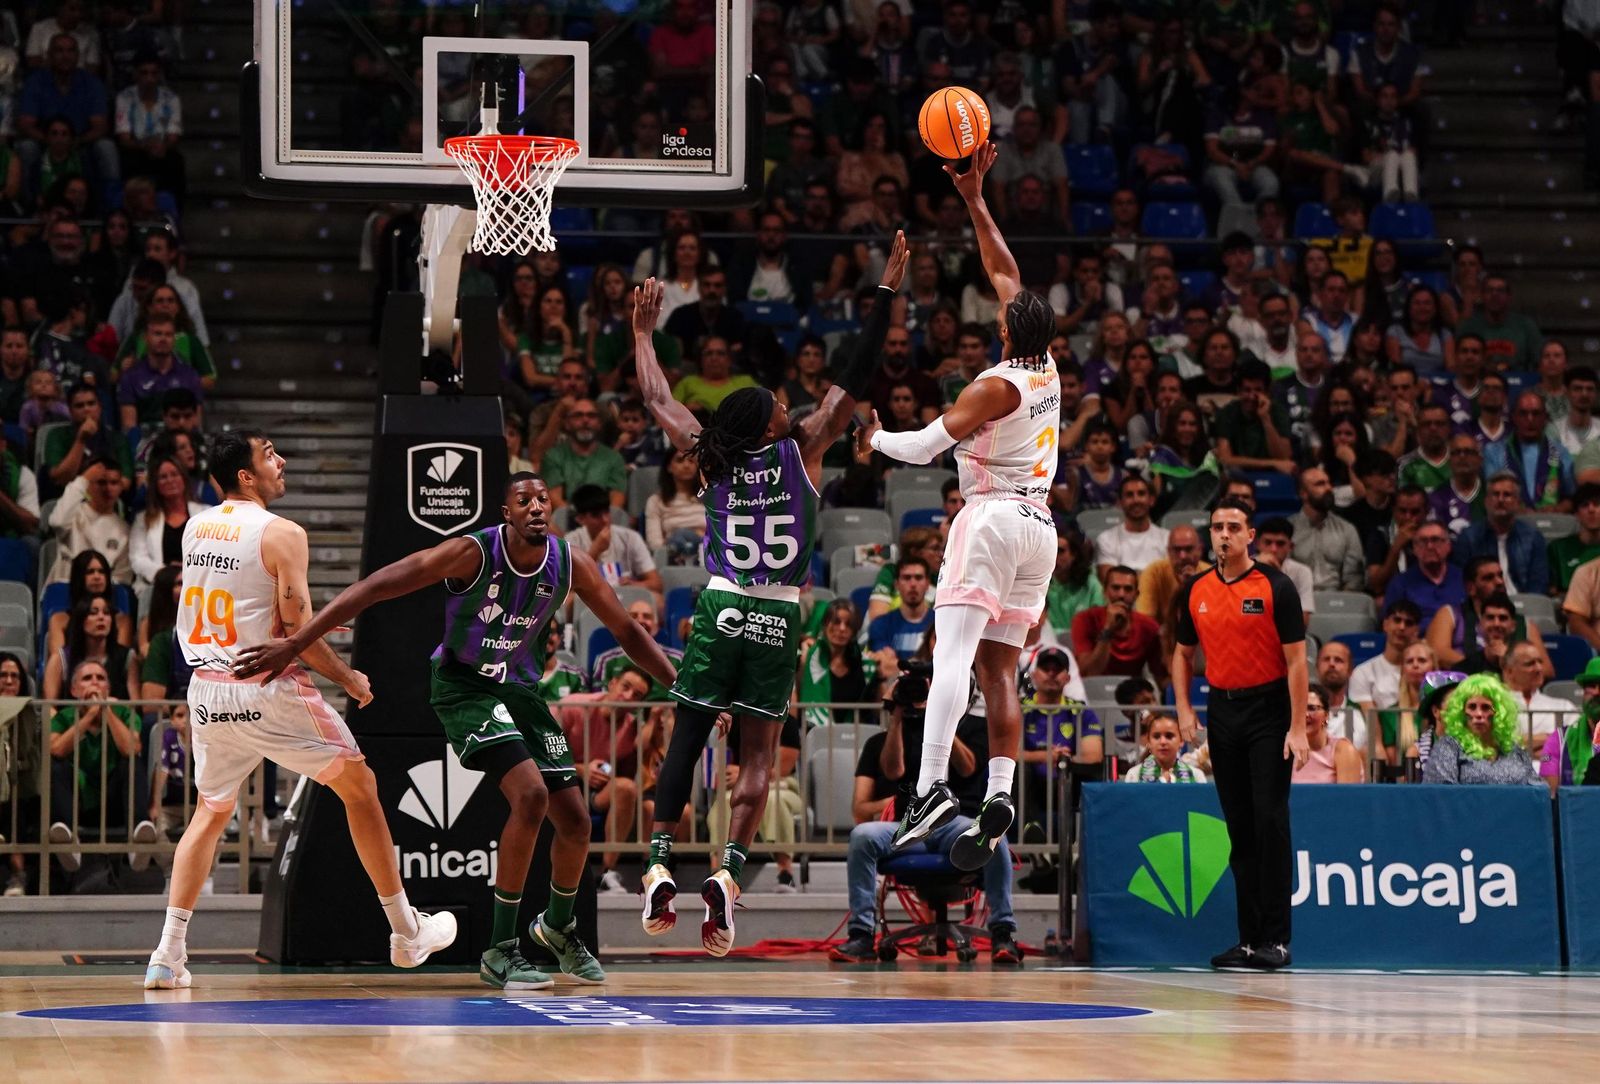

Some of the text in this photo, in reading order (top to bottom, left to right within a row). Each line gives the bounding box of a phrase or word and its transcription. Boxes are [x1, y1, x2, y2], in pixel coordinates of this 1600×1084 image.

[956, 100, 975, 149] Wilson
[662, 133, 686, 147] liga
[662, 145, 712, 157] endesa
[1033, 426, 1055, 477] 2
[732, 466, 782, 486] Perry
[419, 486, 471, 497] Fundación
[419, 506, 471, 516] Baloncesto
[427, 497, 464, 509] Unicaja
[195, 522, 241, 543] ORIOLA
[725, 514, 799, 570] 55
[184, 586, 238, 649] 29
[746, 611, 788, 629] COSTA
[744, 622, 787, 639] DEL SOL
[743, 631, 784, 648] MÁLAGA
[210, 709, 262, 722] serveto
[393, 840, 499, 887] nicaj
